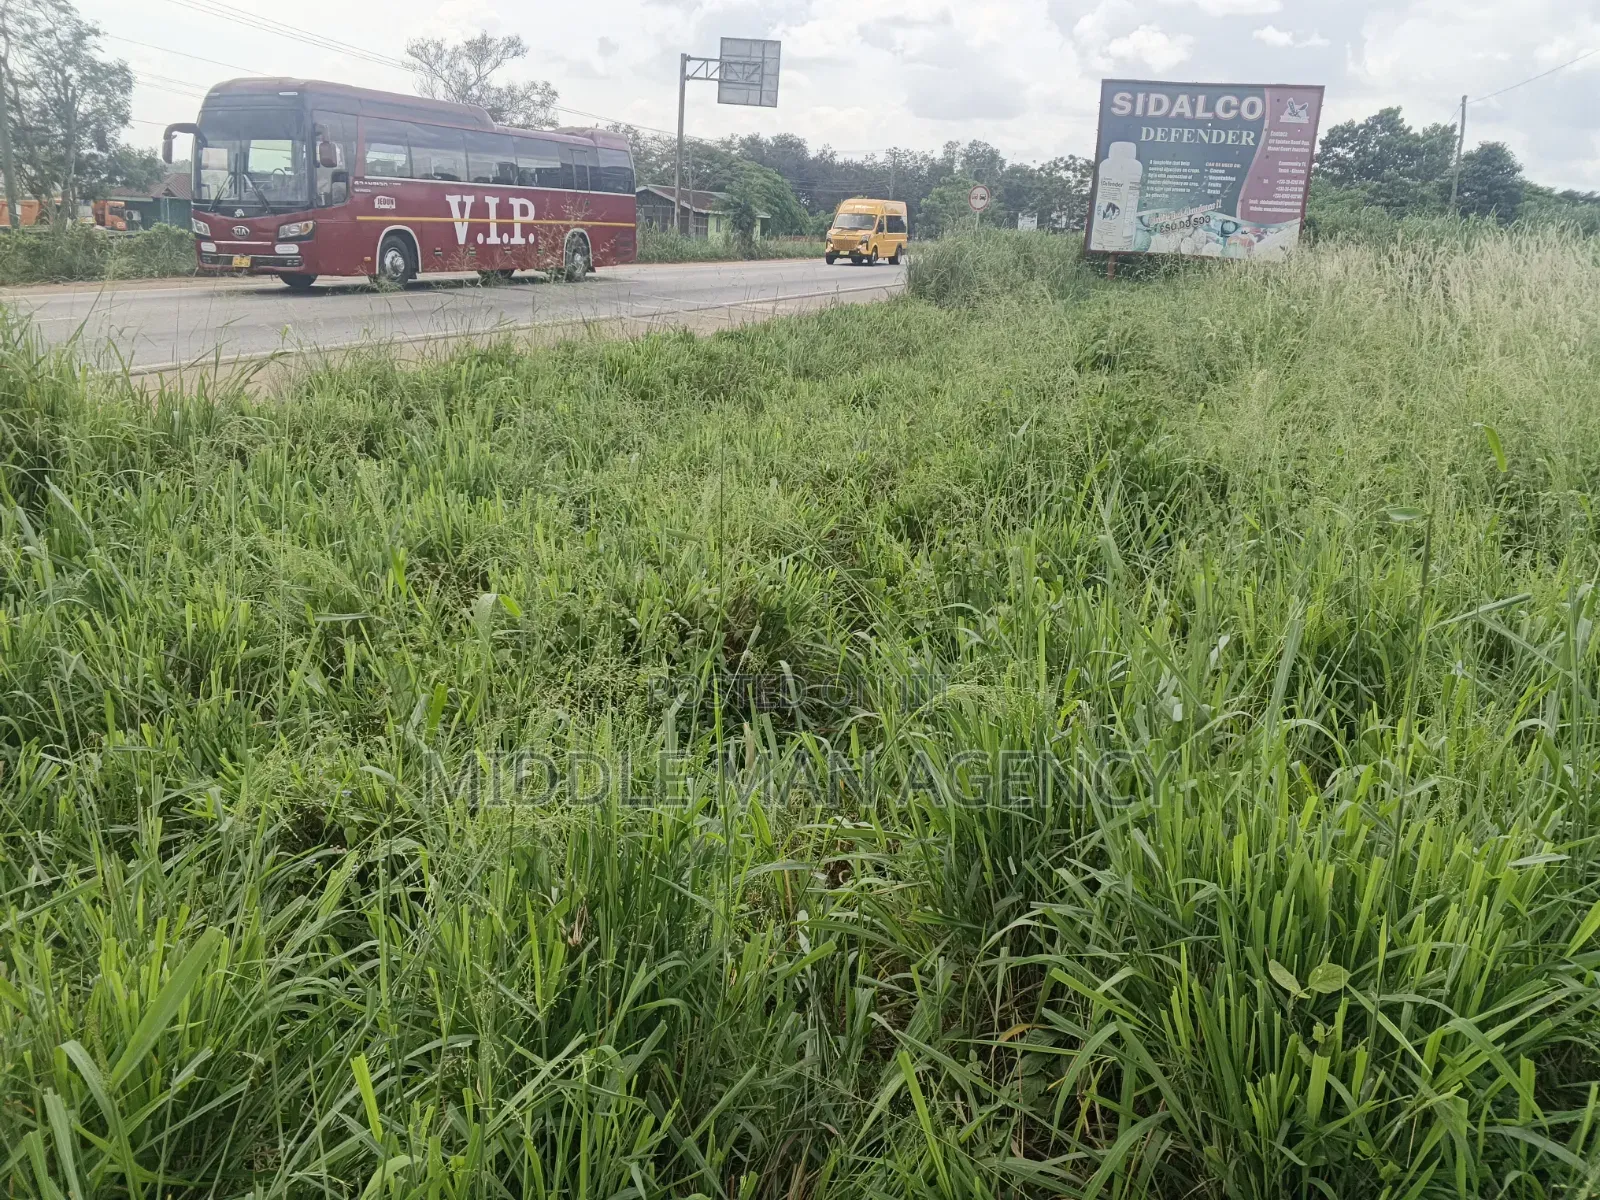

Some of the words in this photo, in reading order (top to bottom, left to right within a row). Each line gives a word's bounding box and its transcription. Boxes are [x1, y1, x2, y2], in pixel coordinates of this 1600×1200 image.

[1110, 92, 1264, 120] SIDALCO
[1140, 126, 1256, 146] DEFENDER
[233, 228, 247, 236] KIA
